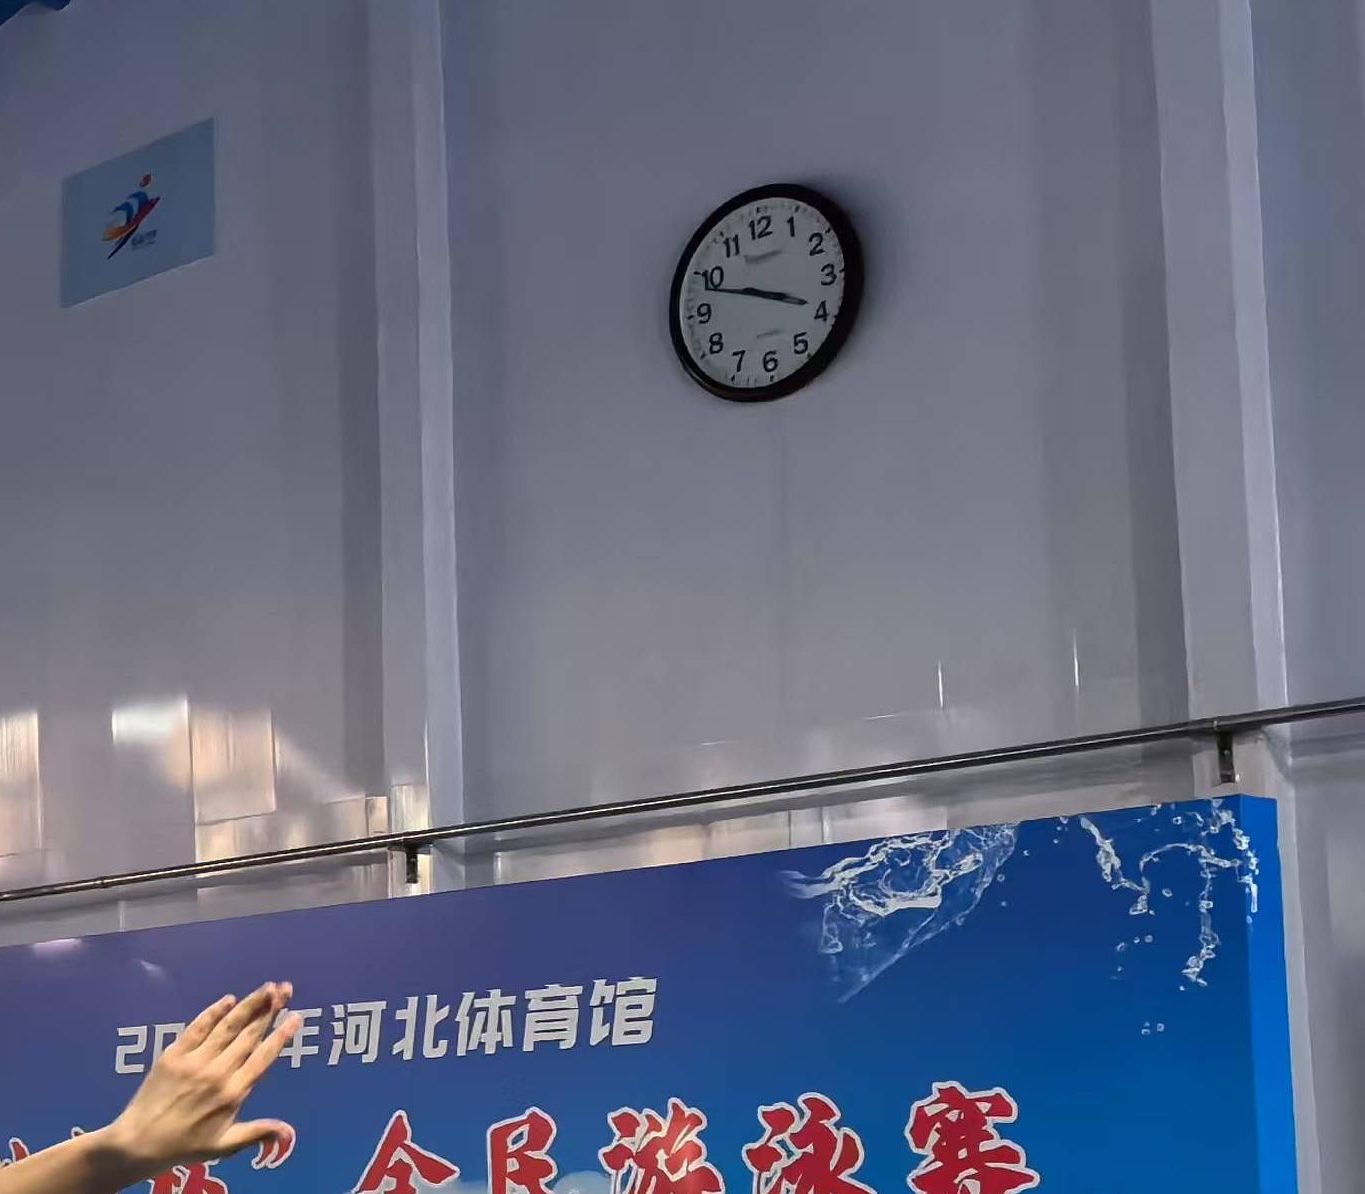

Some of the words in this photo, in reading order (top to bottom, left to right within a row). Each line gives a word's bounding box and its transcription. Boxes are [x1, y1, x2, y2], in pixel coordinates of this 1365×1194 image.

[748, 215, 773, 241] 12
[787, 216, 796, 238] 1
[723, 233, 740, 258] 11
[808, 232, 825, 256] 2
[700, 265, 724, 291] 10
[820, 263, 838, 286] 3
[696, 302, 712, 324] 9
[814, 300, 830, 323] 4
[708, 332, 724, 354] 8
[793, 331, 809, 355] 5
[732, 350, 746, 373] 7
[762, 350, 779, 373] 6
[115, 976, 658, 1074] 20年河北体育馆
